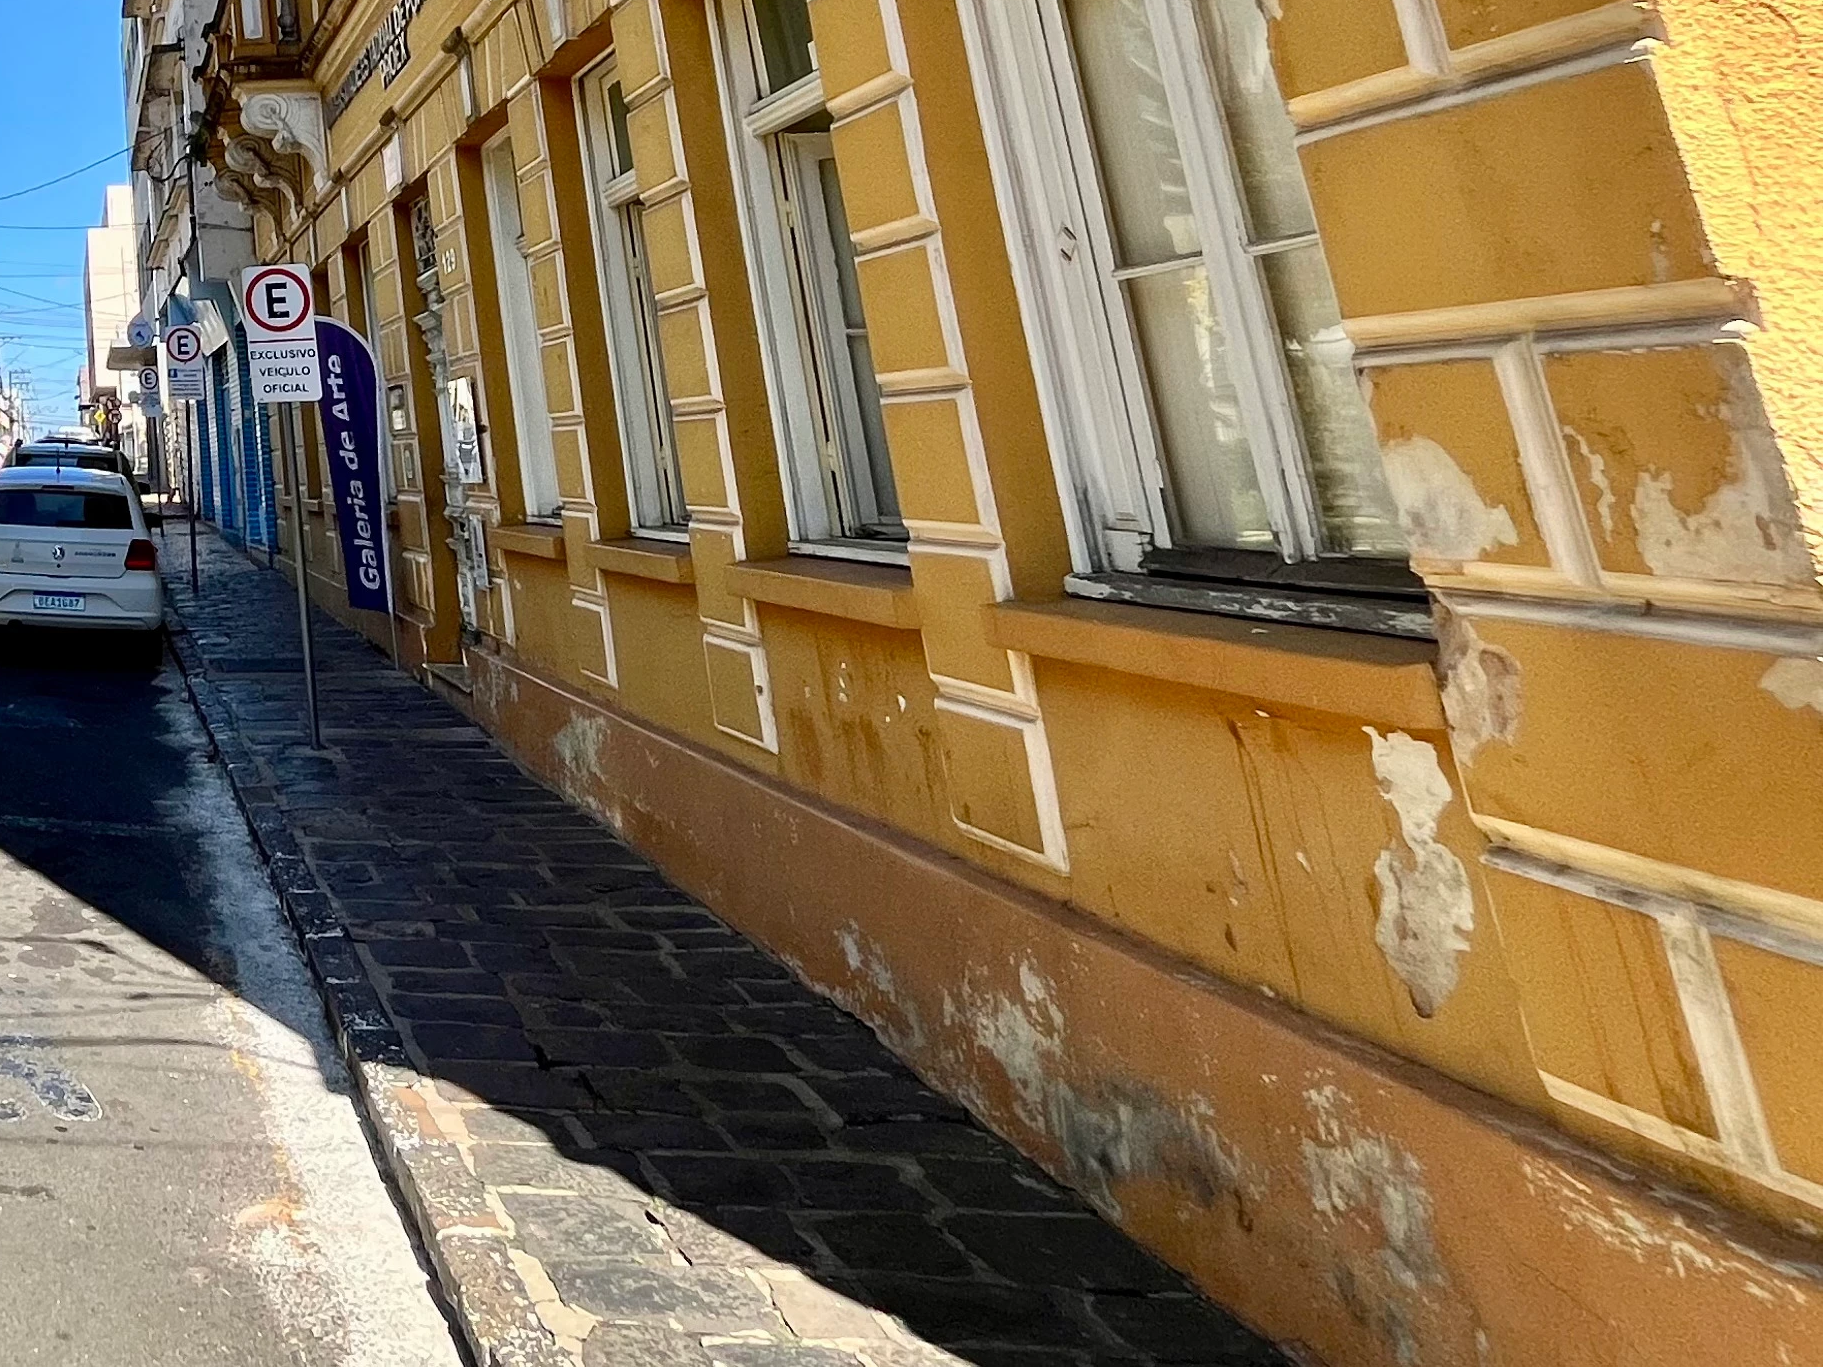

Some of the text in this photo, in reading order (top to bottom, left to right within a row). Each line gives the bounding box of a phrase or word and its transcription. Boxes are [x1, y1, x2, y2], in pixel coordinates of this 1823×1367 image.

[265, 282, 290, 319] E
[177, 335, 190, 355] E
[250, 349, 316, 360] EXCLUSIVO
[263, 383, 310, 394] OFICIAL
[327, 354, 381, 590] Galeria de Arte
